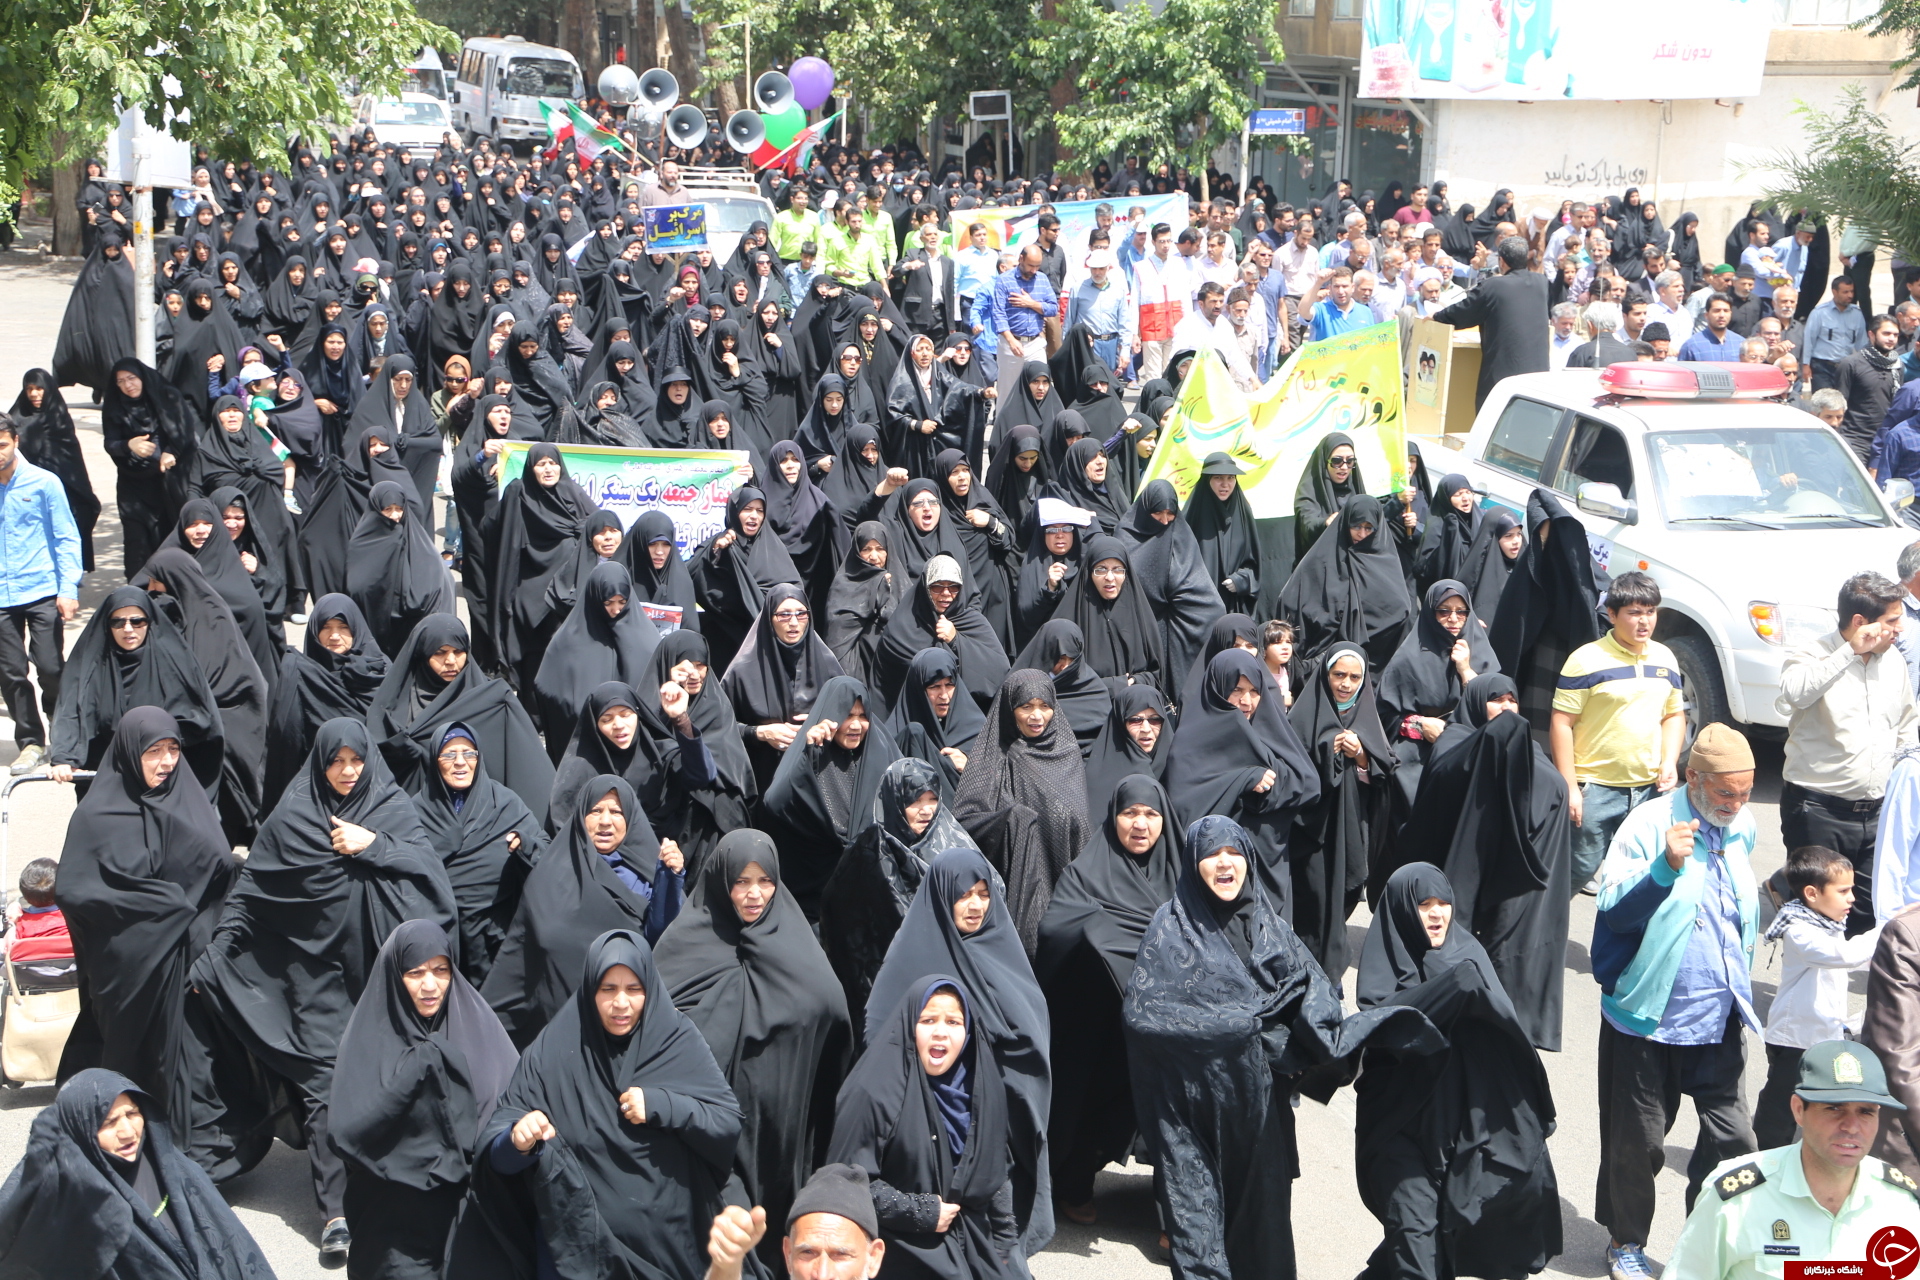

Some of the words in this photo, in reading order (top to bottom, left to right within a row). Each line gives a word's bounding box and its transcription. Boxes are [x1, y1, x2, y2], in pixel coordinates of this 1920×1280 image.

[1652, 40, 1678, 60] شکر
[1681, 44, 1712, 62] بدون
[1265, 118, 1281, 126] خمینی
[1281, 118, 1293, 126] امام
[1587, 156, 1612, 189] پارک
[1613, 164, 1628, 187] پل
[1628, 165, 1648, 187] روی
[667, 210, 678, 223] بر
[677, 206, 703, 221] مرگ
[648, 220, 706, 242] اسرائیل
[1353, 381, 1398, 430] روز
[596, 474, 635, 510] سنگر
[633, 476, 661, 511] یک
[661, 481, 700, 513] جمعه
[1594, 543, 1609, 562] مرگ
